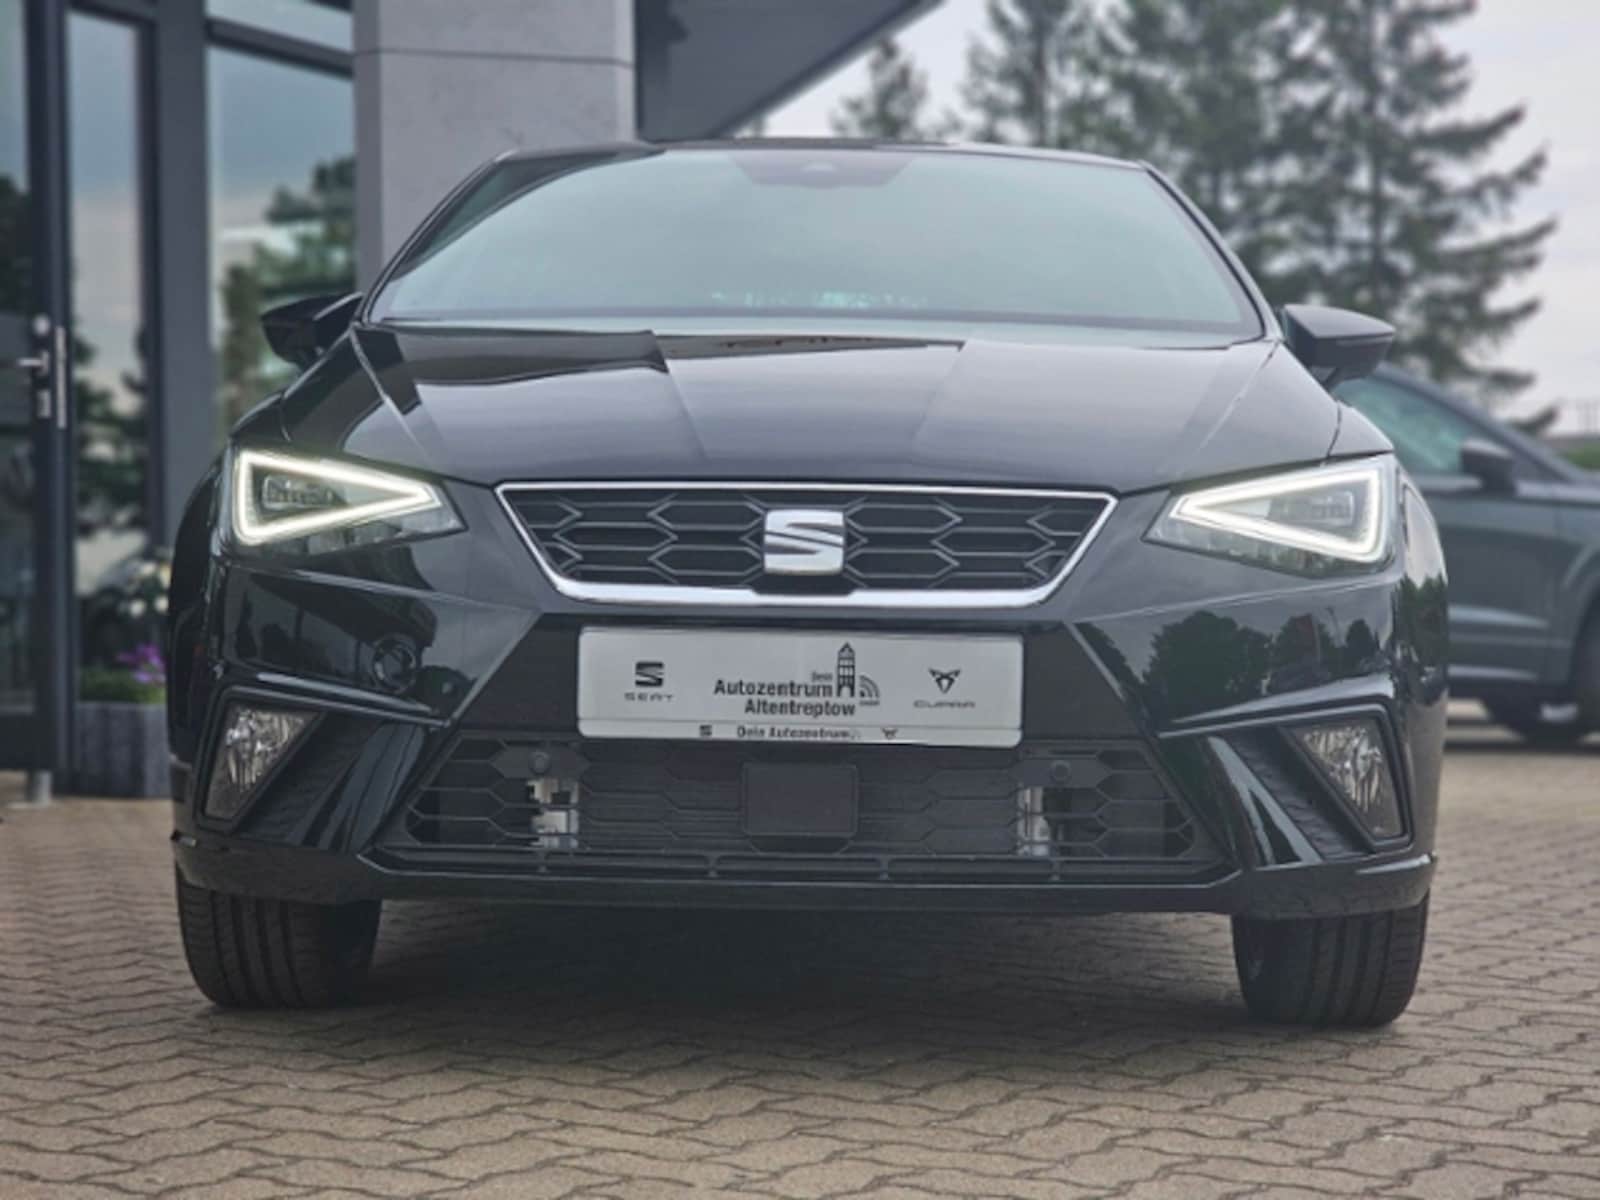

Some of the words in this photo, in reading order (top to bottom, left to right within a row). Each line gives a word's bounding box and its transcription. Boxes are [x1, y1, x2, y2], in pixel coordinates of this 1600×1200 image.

[624, 691, 674, 702] SEAT
[713, 678, 833, 697] Autozentrum
[744, 699, 856, 718] Altentreptow
